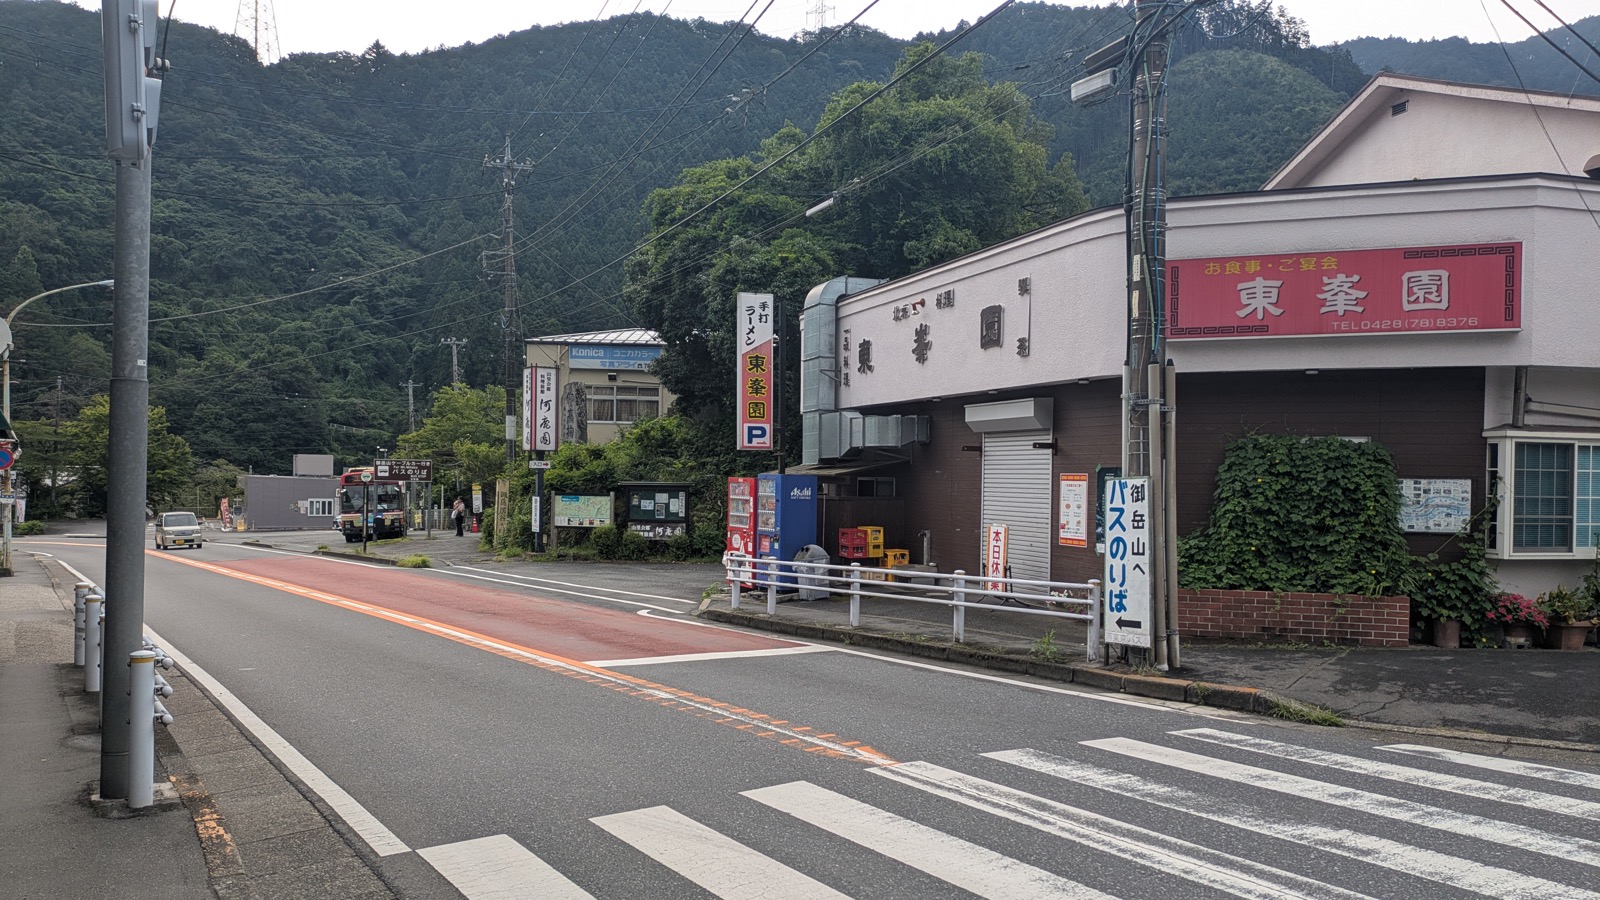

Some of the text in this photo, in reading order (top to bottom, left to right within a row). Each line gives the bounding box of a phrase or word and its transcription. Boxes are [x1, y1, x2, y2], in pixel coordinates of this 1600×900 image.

[1204, 255, 1338, 276] お食事・ご宴会
[1234, 269, 1451, 321] 東峯園
[758, 300, 770, 324] 手打
[744, 305, 756, 347] ラーメン
[571, 347, 605, 357] Konica
[613, 350, 654, 358] コニカカラー
[747, 353, 767, 420] 東峯園
[747, 425, 767, 445] P
[790, 486, 812, 496] Asahi
[1130, 483, 1146, 576] 御岳山へ
[1108, 480, 1128, 614] バスのりば
